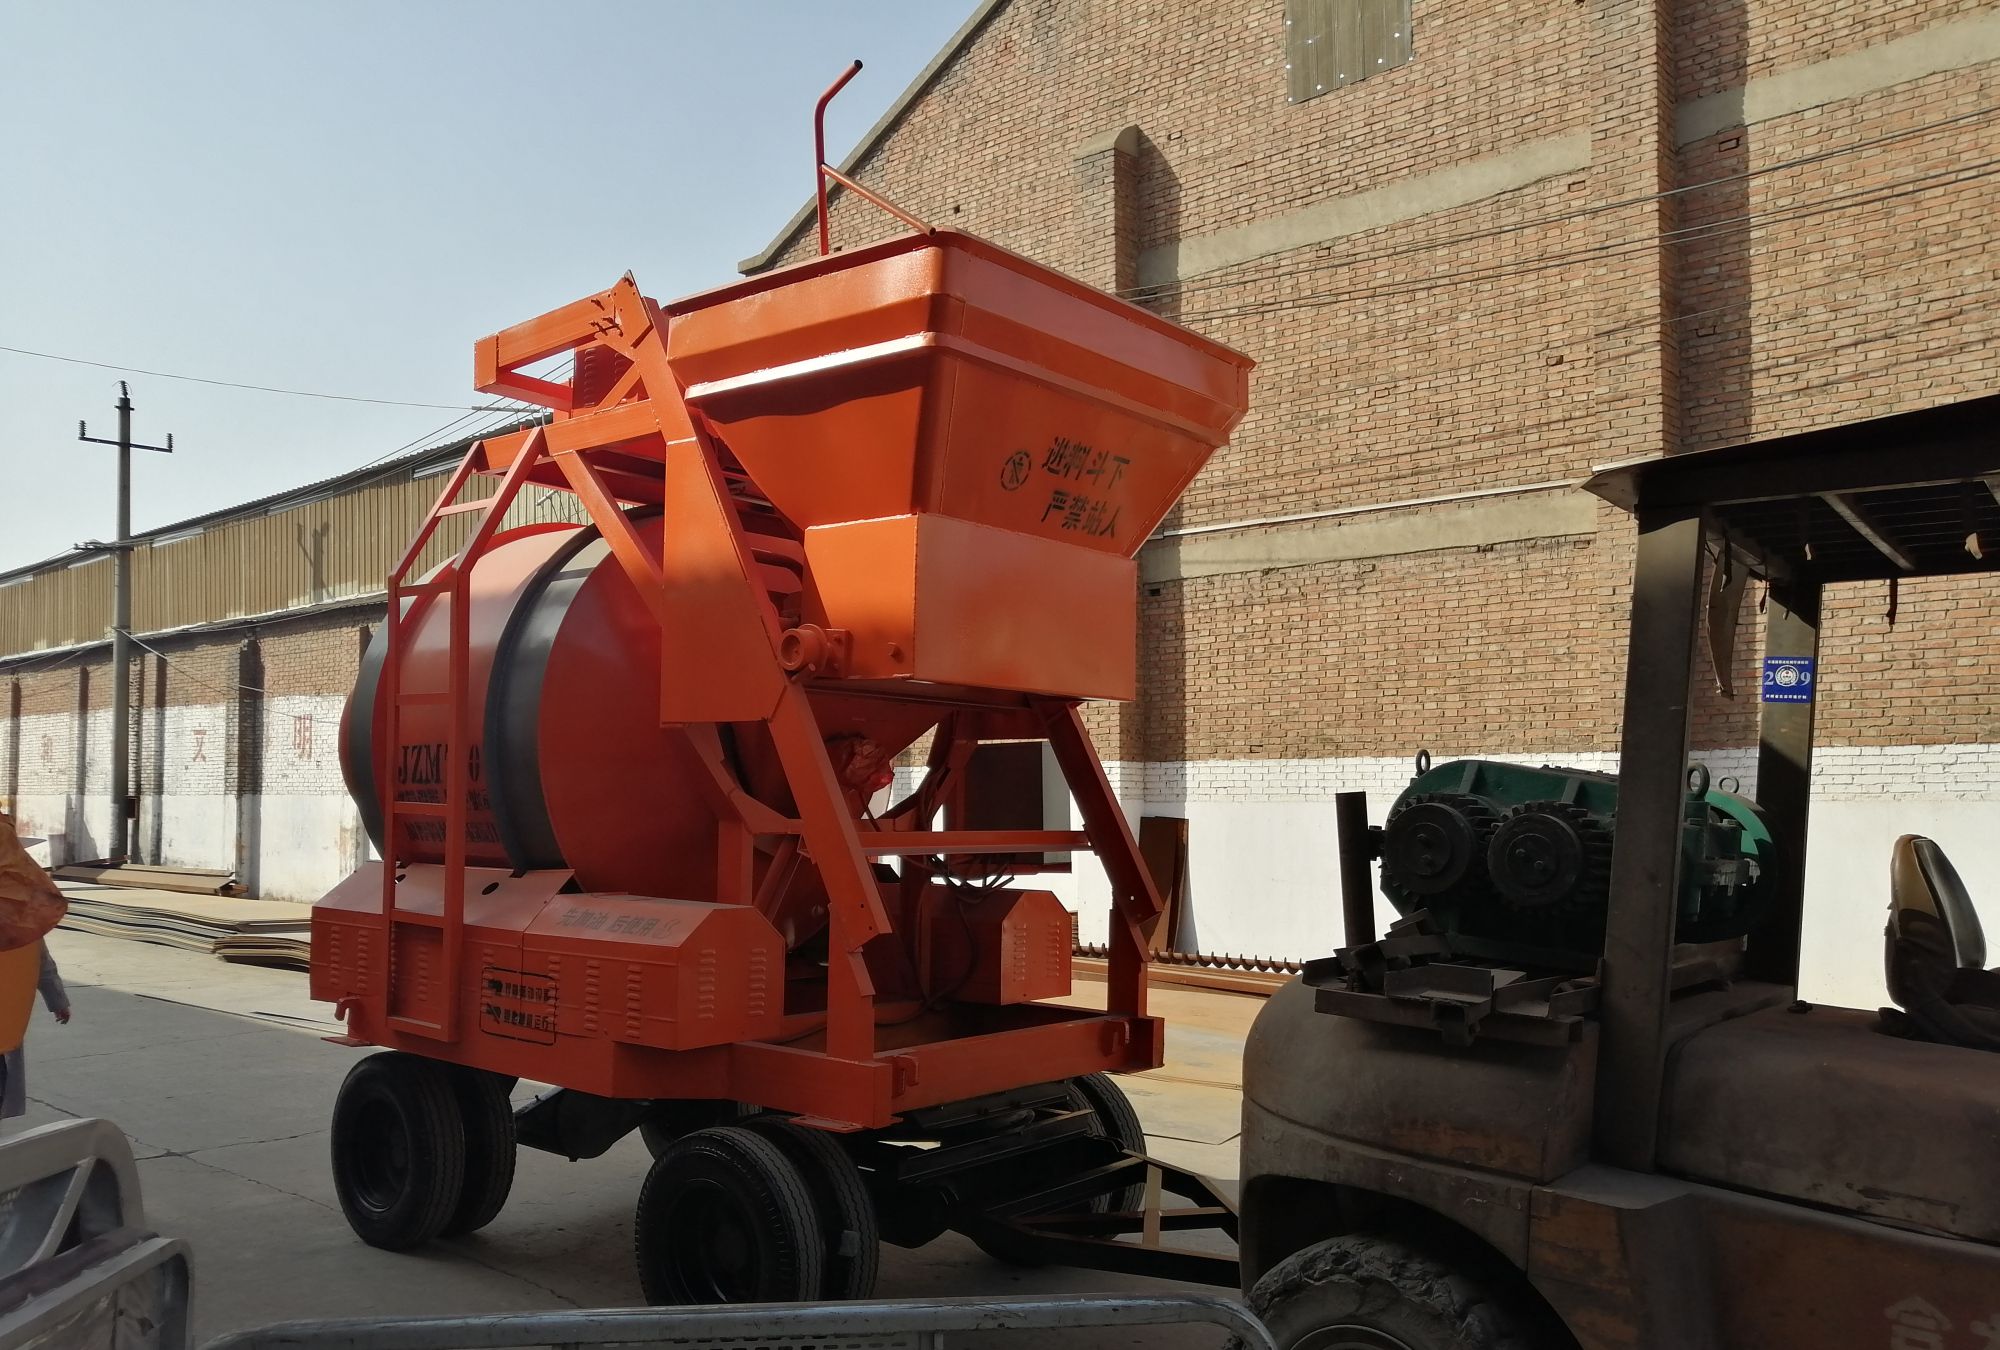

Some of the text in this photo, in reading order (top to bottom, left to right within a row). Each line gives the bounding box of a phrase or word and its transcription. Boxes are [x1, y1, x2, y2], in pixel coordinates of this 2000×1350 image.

[1041, 435, 1131, 490] 进料斗下
[1041, 490, 1120, 539] 严禁站人
[397, 743, 480, 785] JZM0
